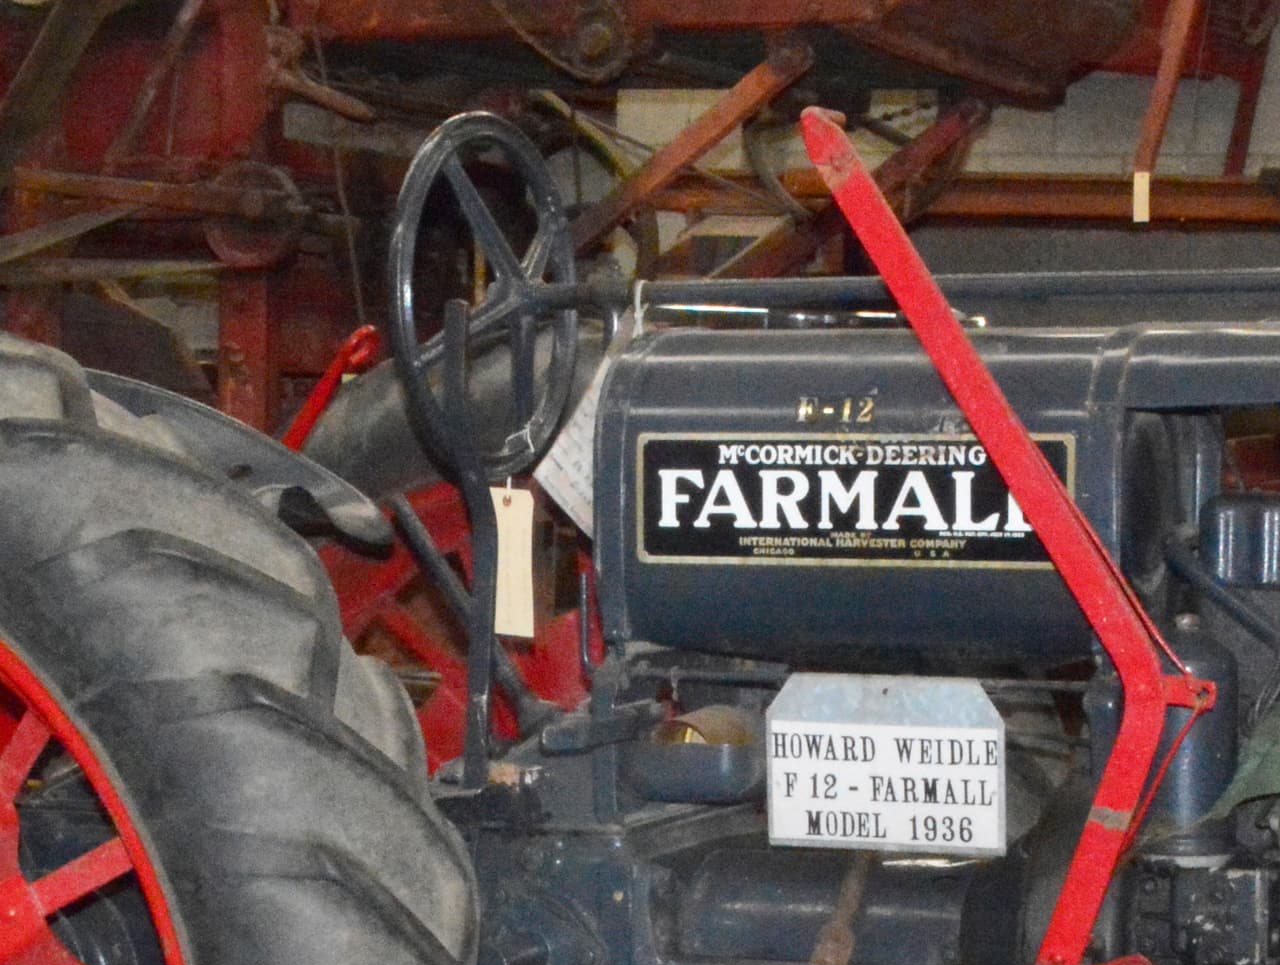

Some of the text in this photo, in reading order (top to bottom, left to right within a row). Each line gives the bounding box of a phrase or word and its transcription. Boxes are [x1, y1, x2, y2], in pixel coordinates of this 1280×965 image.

[739, 536, 967, 549] INTERNATIONAL HARVESTER COMPANY
[772, 732, 998, 766] HOWARD WEIDLE
[784, 772, 798, 798] F
[811, 774, 838, 799] 12
[870, 776, 993, 806] FARMALL
[805, 810, 973, 842] MODEL 1936
